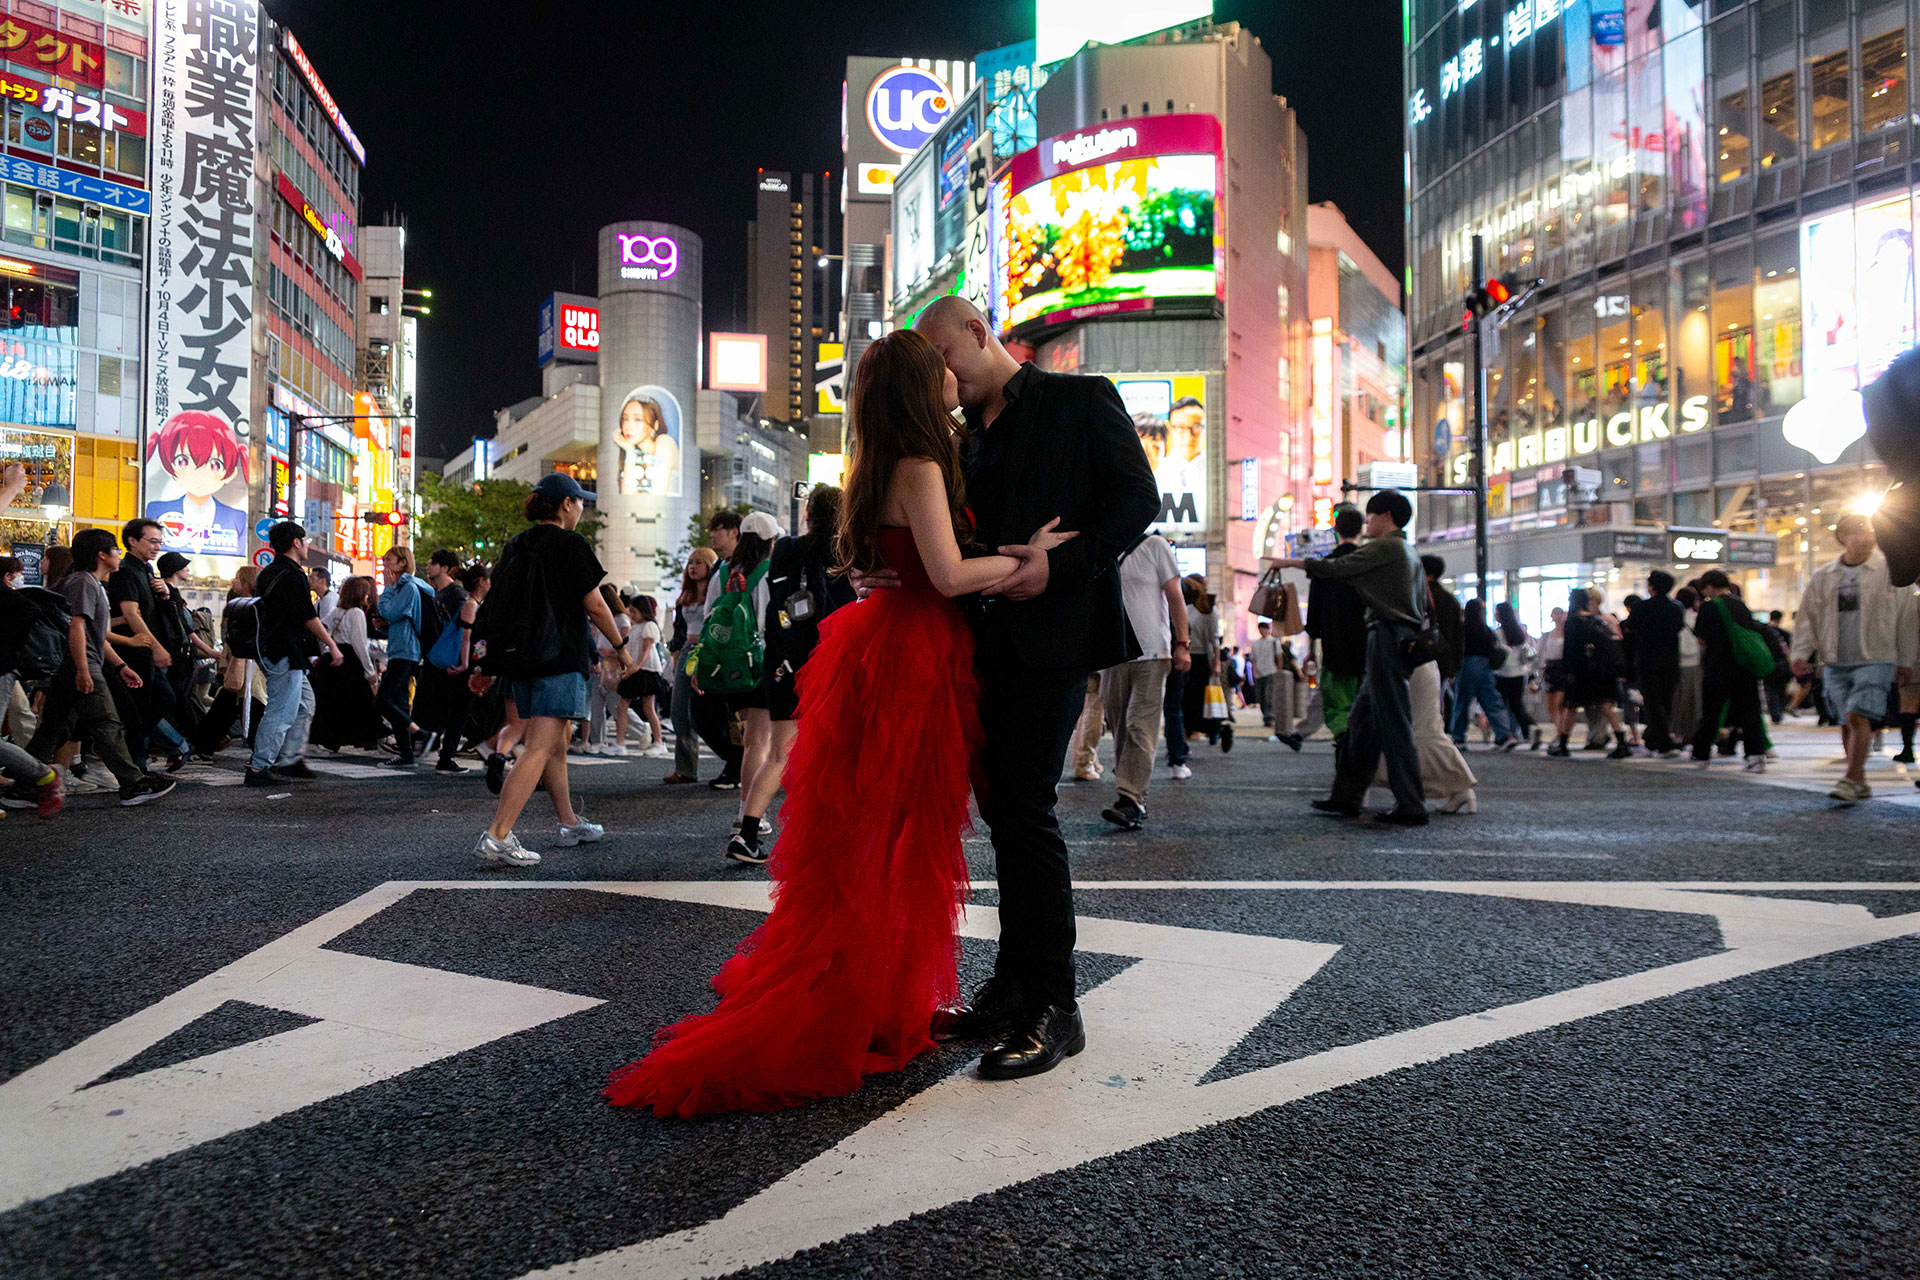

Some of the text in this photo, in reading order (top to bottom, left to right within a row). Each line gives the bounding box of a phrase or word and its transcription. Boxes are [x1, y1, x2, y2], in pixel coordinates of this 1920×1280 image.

[41, 87, 129, 131] ガスト
[1053, 127, 1137, 166] Rakuten
[617, 233, 679, 279] 109
[564, 309, 597, 330] UNI
[564, 326, 599, 347] QLO
[1454, 395, 1709, 484] SARBUCKS
